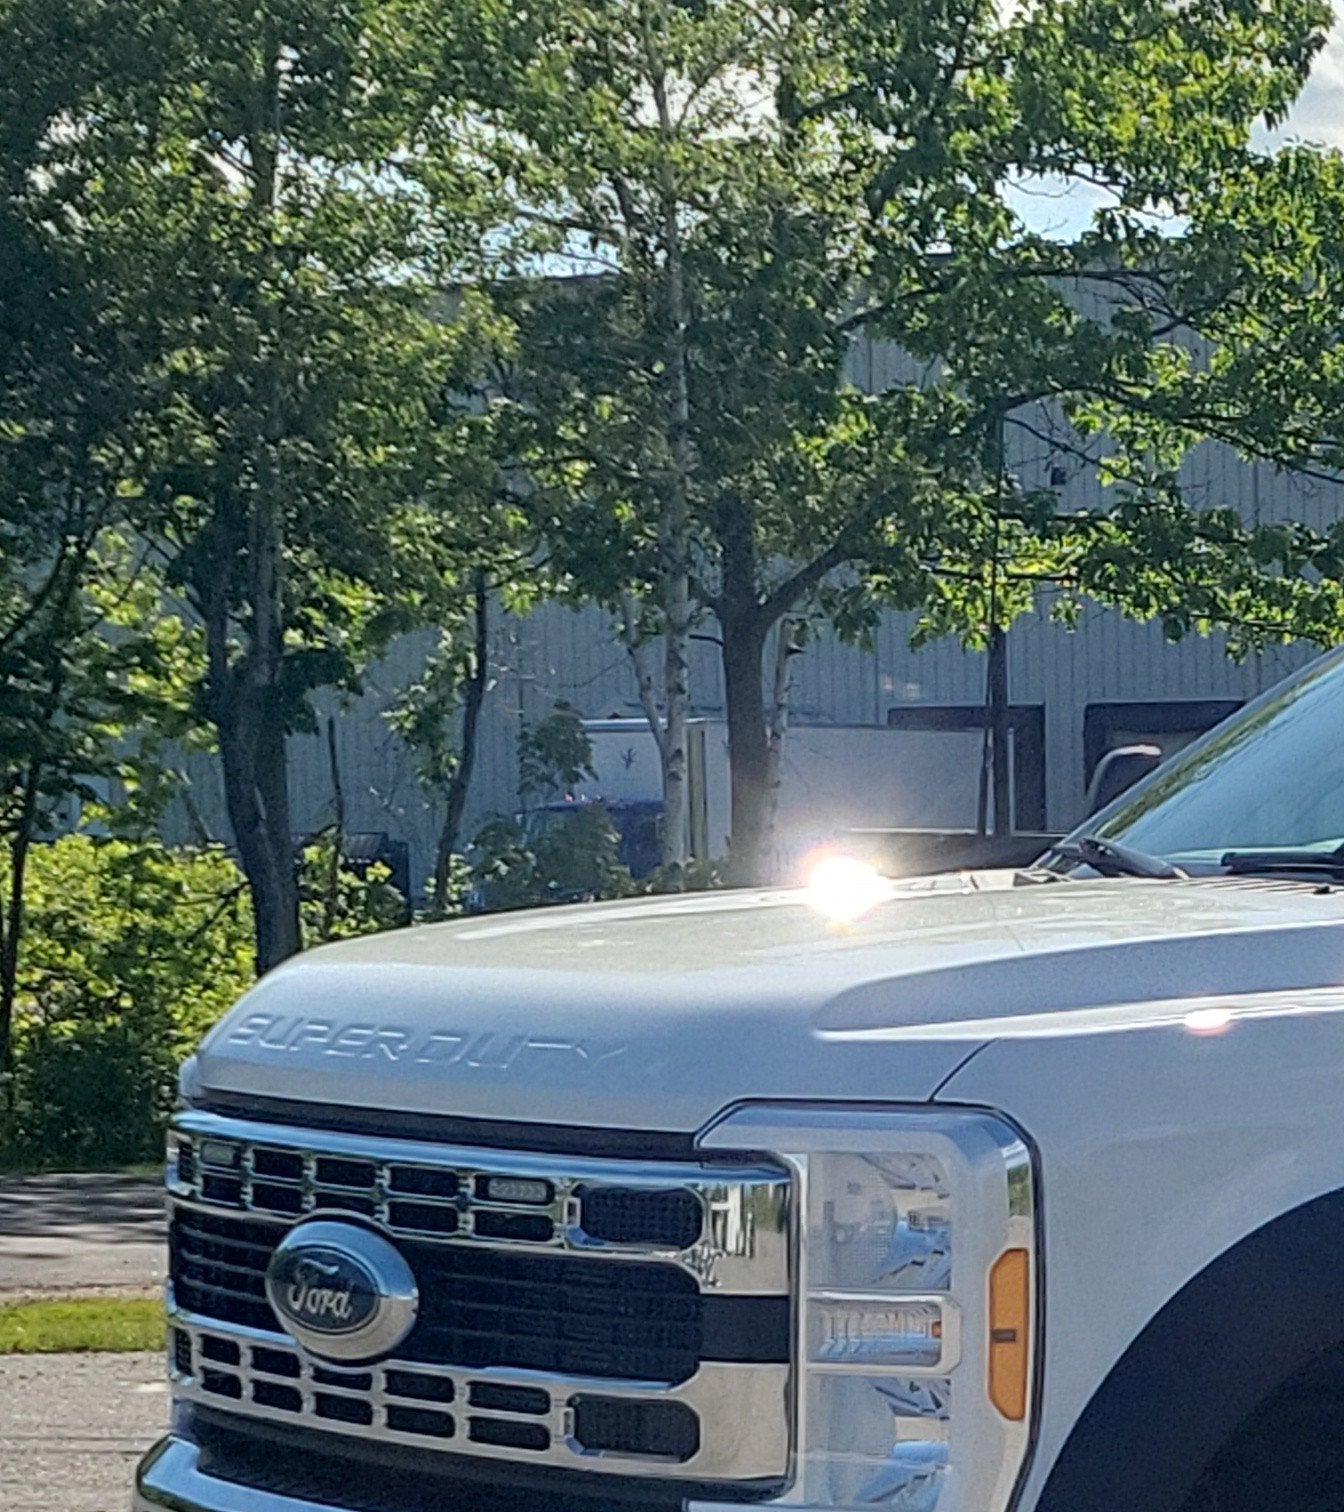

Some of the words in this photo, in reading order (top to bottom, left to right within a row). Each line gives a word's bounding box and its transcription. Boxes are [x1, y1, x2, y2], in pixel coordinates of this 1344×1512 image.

[227, 1012, 408, 1062] SUPER
[414, 1032, 628, 1071] DUTY
[287, 1268, 354, 1319] Ford
